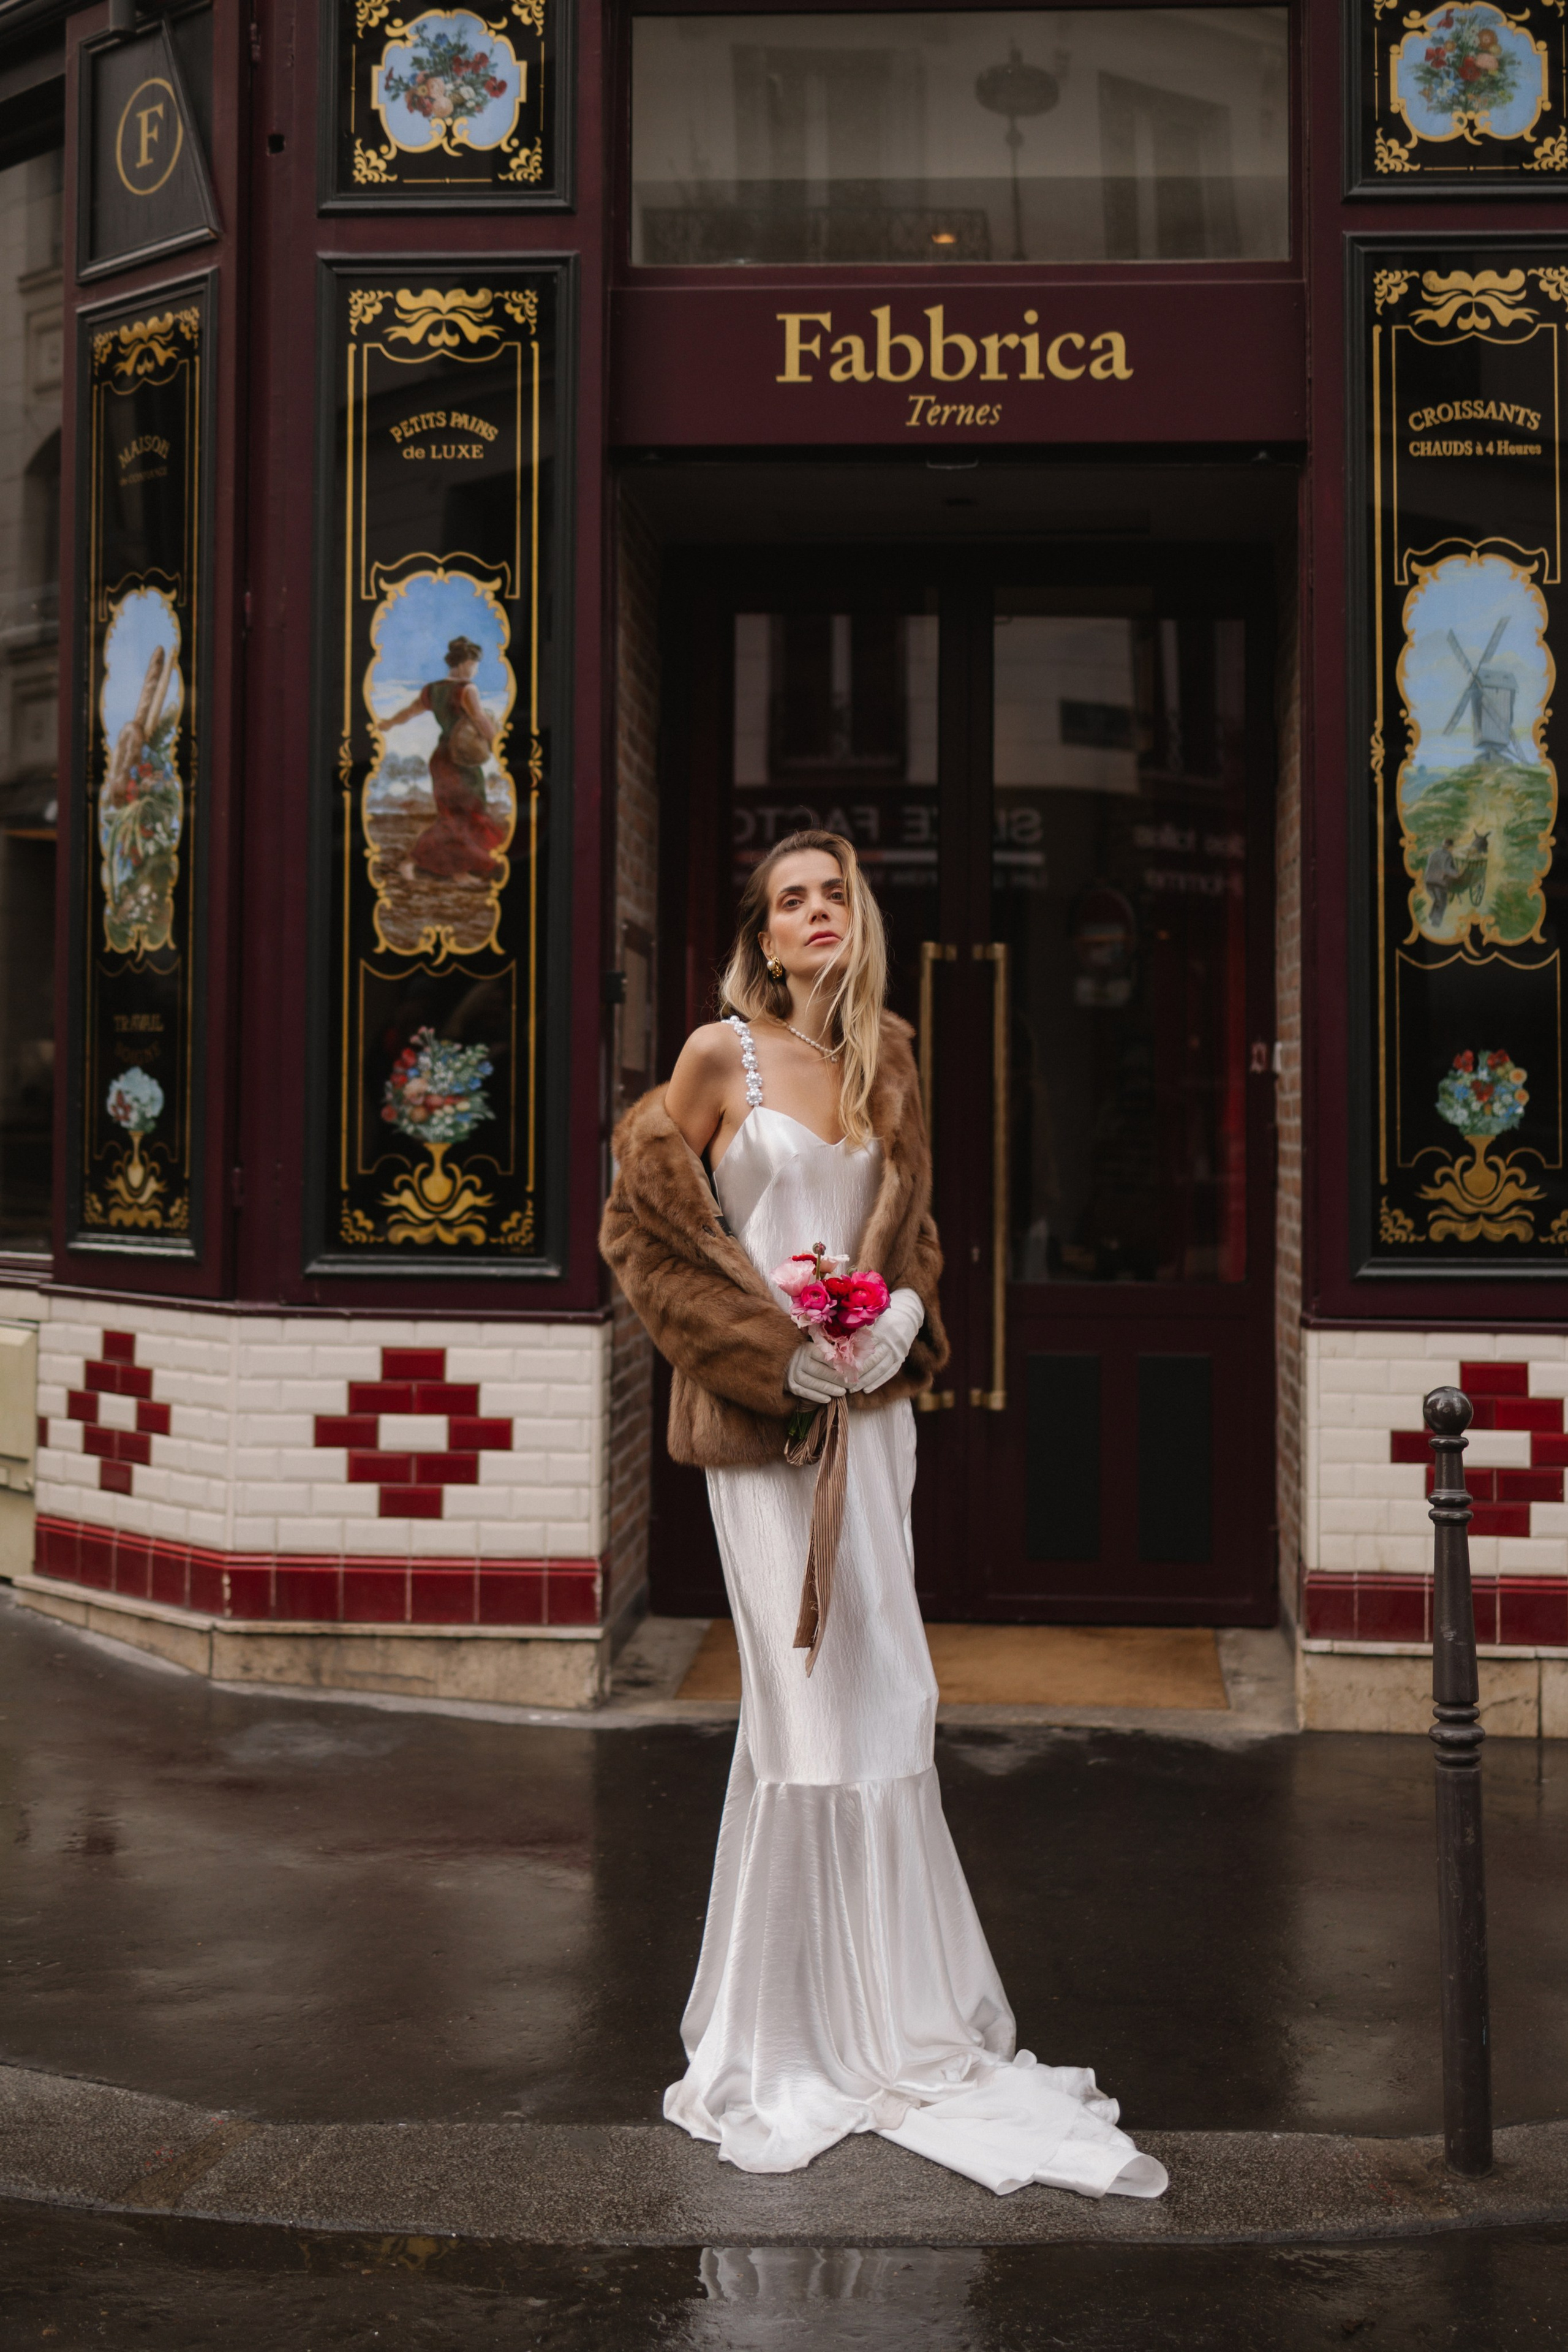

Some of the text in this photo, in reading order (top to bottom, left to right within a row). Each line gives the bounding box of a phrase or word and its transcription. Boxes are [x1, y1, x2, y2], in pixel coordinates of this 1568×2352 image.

[135, 102, 164, 169] F
[775, 304, 1134, 383] Fabbrica
[905, 394, 1003, 426] Ternes
[1408, 400, 1542, 431] CROISSANTS
[389, 411, 499, 444] PETITS PAINS
[118, 434, 170, 470] MAISON
[402, 444, 484, 459] de LUXE
[1409, 440, 1473, 458] CHAUDS
[1485, 440, 1495, 456] 4
[1496, 439, 1542, 456] Heures
